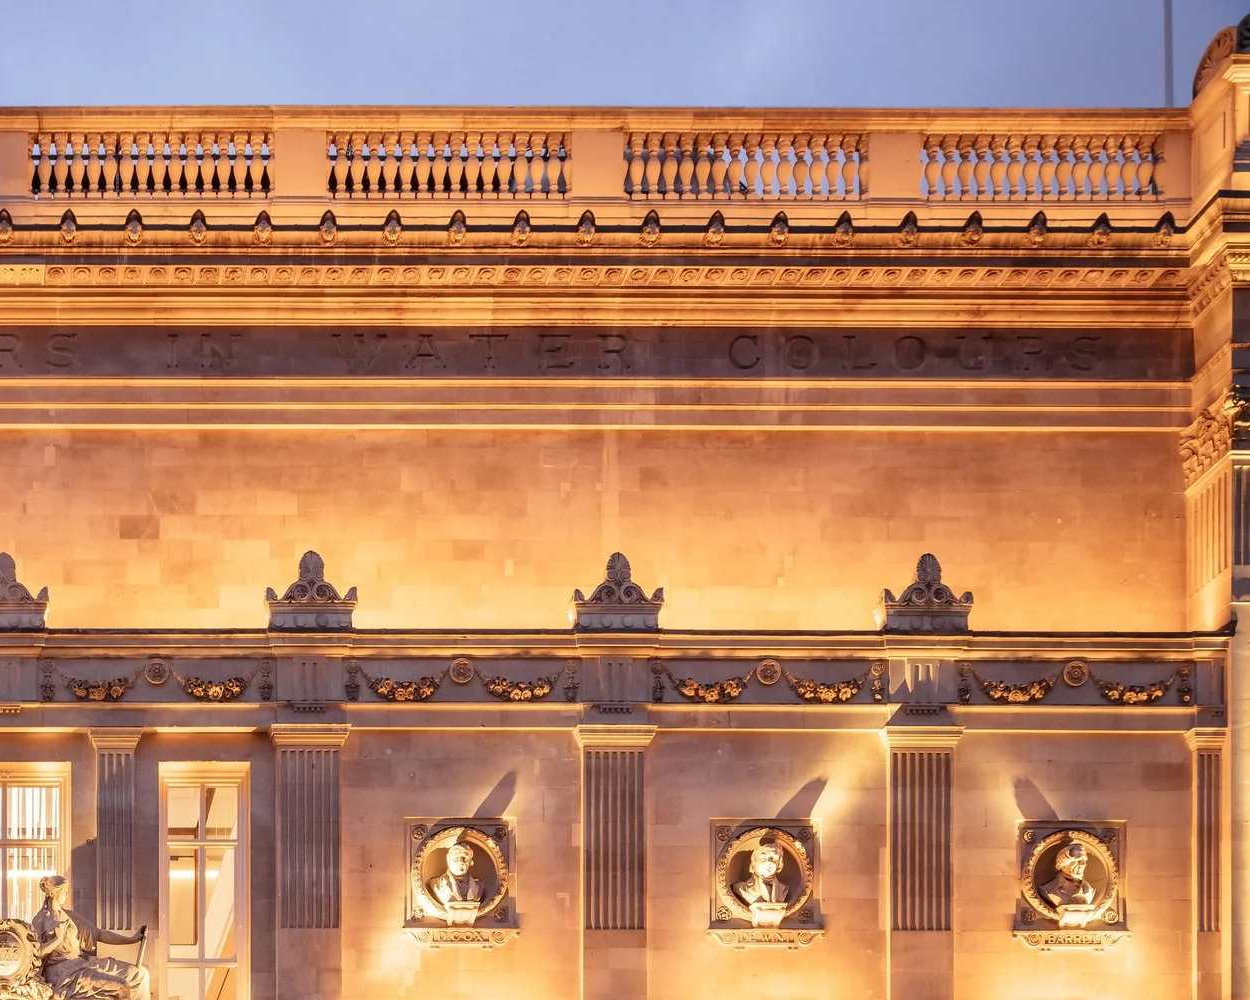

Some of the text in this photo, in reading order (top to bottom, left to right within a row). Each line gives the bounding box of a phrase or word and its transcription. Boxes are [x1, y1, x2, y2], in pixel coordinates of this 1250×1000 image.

[166, 333, 242, 369] IN
[330, 333, 633, 370] WATER
[727, 334, 1103, 371] COLOURS
[452, 931, 485, 942] COX
